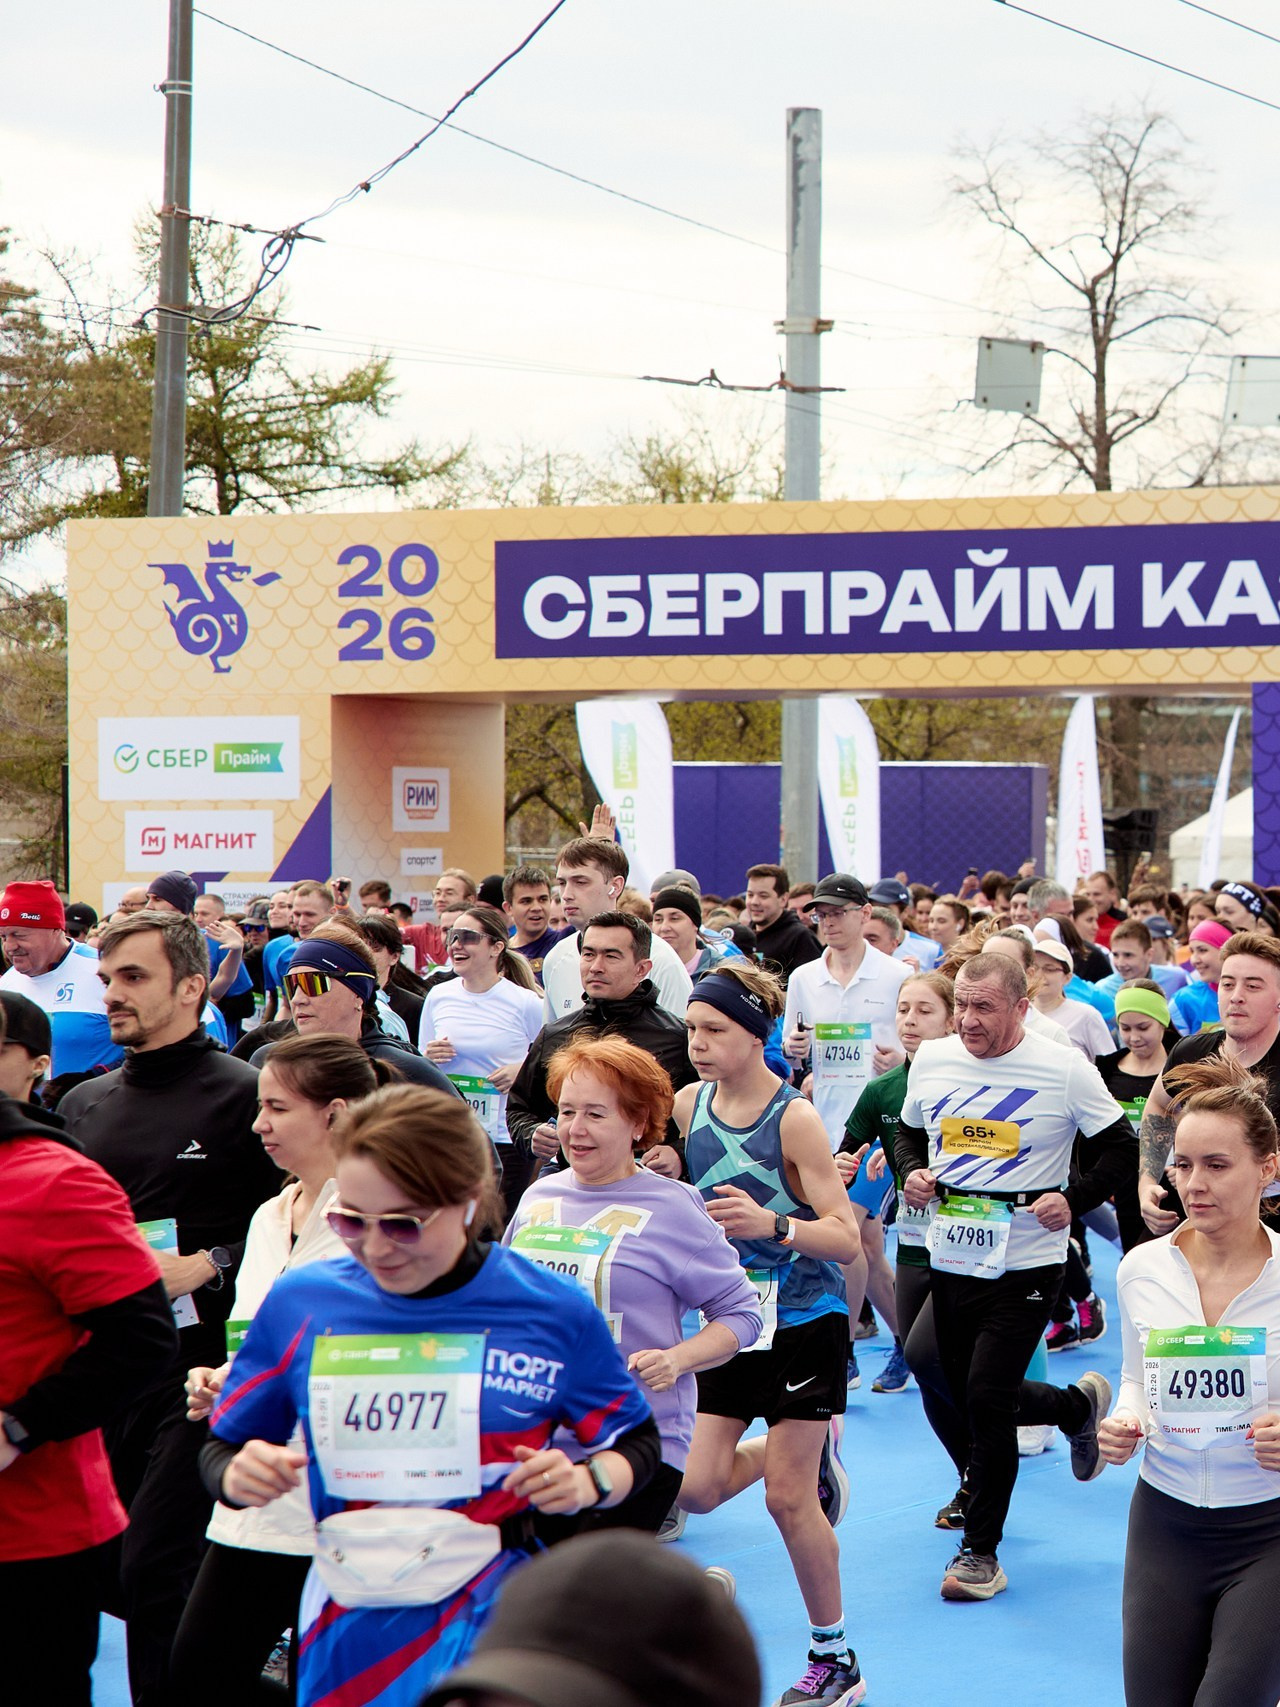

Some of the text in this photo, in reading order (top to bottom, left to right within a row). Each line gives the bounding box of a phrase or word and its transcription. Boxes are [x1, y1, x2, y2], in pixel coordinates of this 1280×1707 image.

[337, 542, 440, 598] 20
[523, 547, 1115, 640] СБЕРПРАЙМ
[337, 606, 437, 662] 26
[146, 748, 271, 768] СБЕР Прайм
[407, 786, 436, 806] РИМ
[174, 833, 256, 850] МАГНИТ
[825, 1046, 860, 1060] 47346
[962, 1125, 997, 1139] 65+
[946, 1225, 994, 1248] 47981
[1165, 1336, 1184, 1344] СБЕР
[486, 1348, 565, 1384] ПОРТ
[484, 1373, 557, 1402] МАРКЕТ
[1169, 1369, 1245, 1399] 49380
[344, 1391, 447, 1432] 46977
[1171, 1426, 1200, 1434] МАГНИТ
